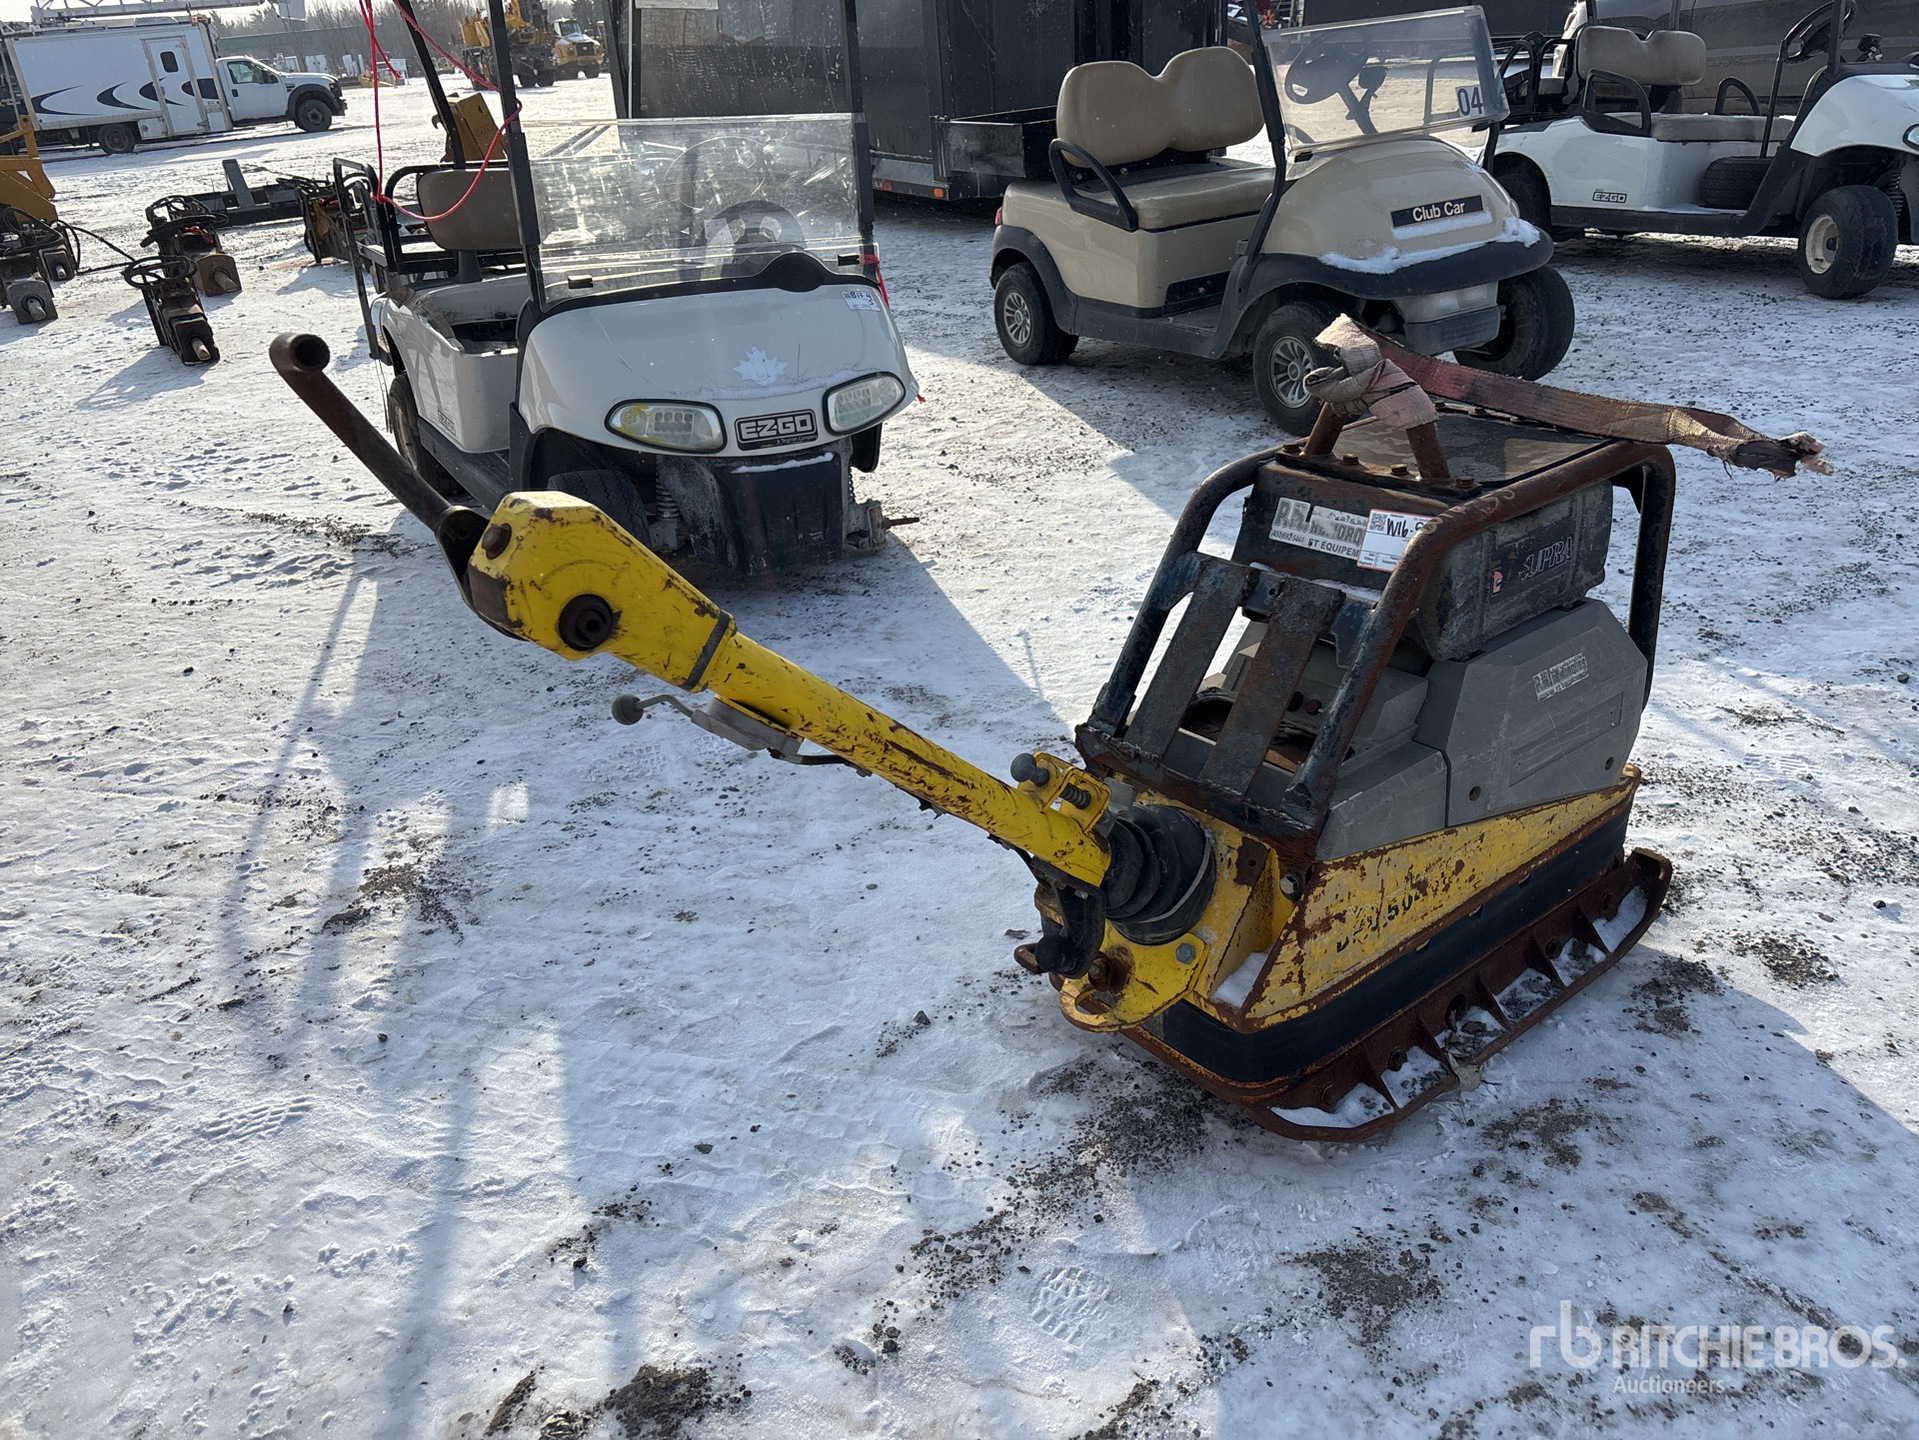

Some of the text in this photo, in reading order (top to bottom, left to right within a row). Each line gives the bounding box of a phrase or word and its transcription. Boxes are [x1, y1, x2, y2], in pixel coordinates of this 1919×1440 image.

[1457, 86, 1483, 116] 04
[1412, 201, 1465, 222] Club Car
